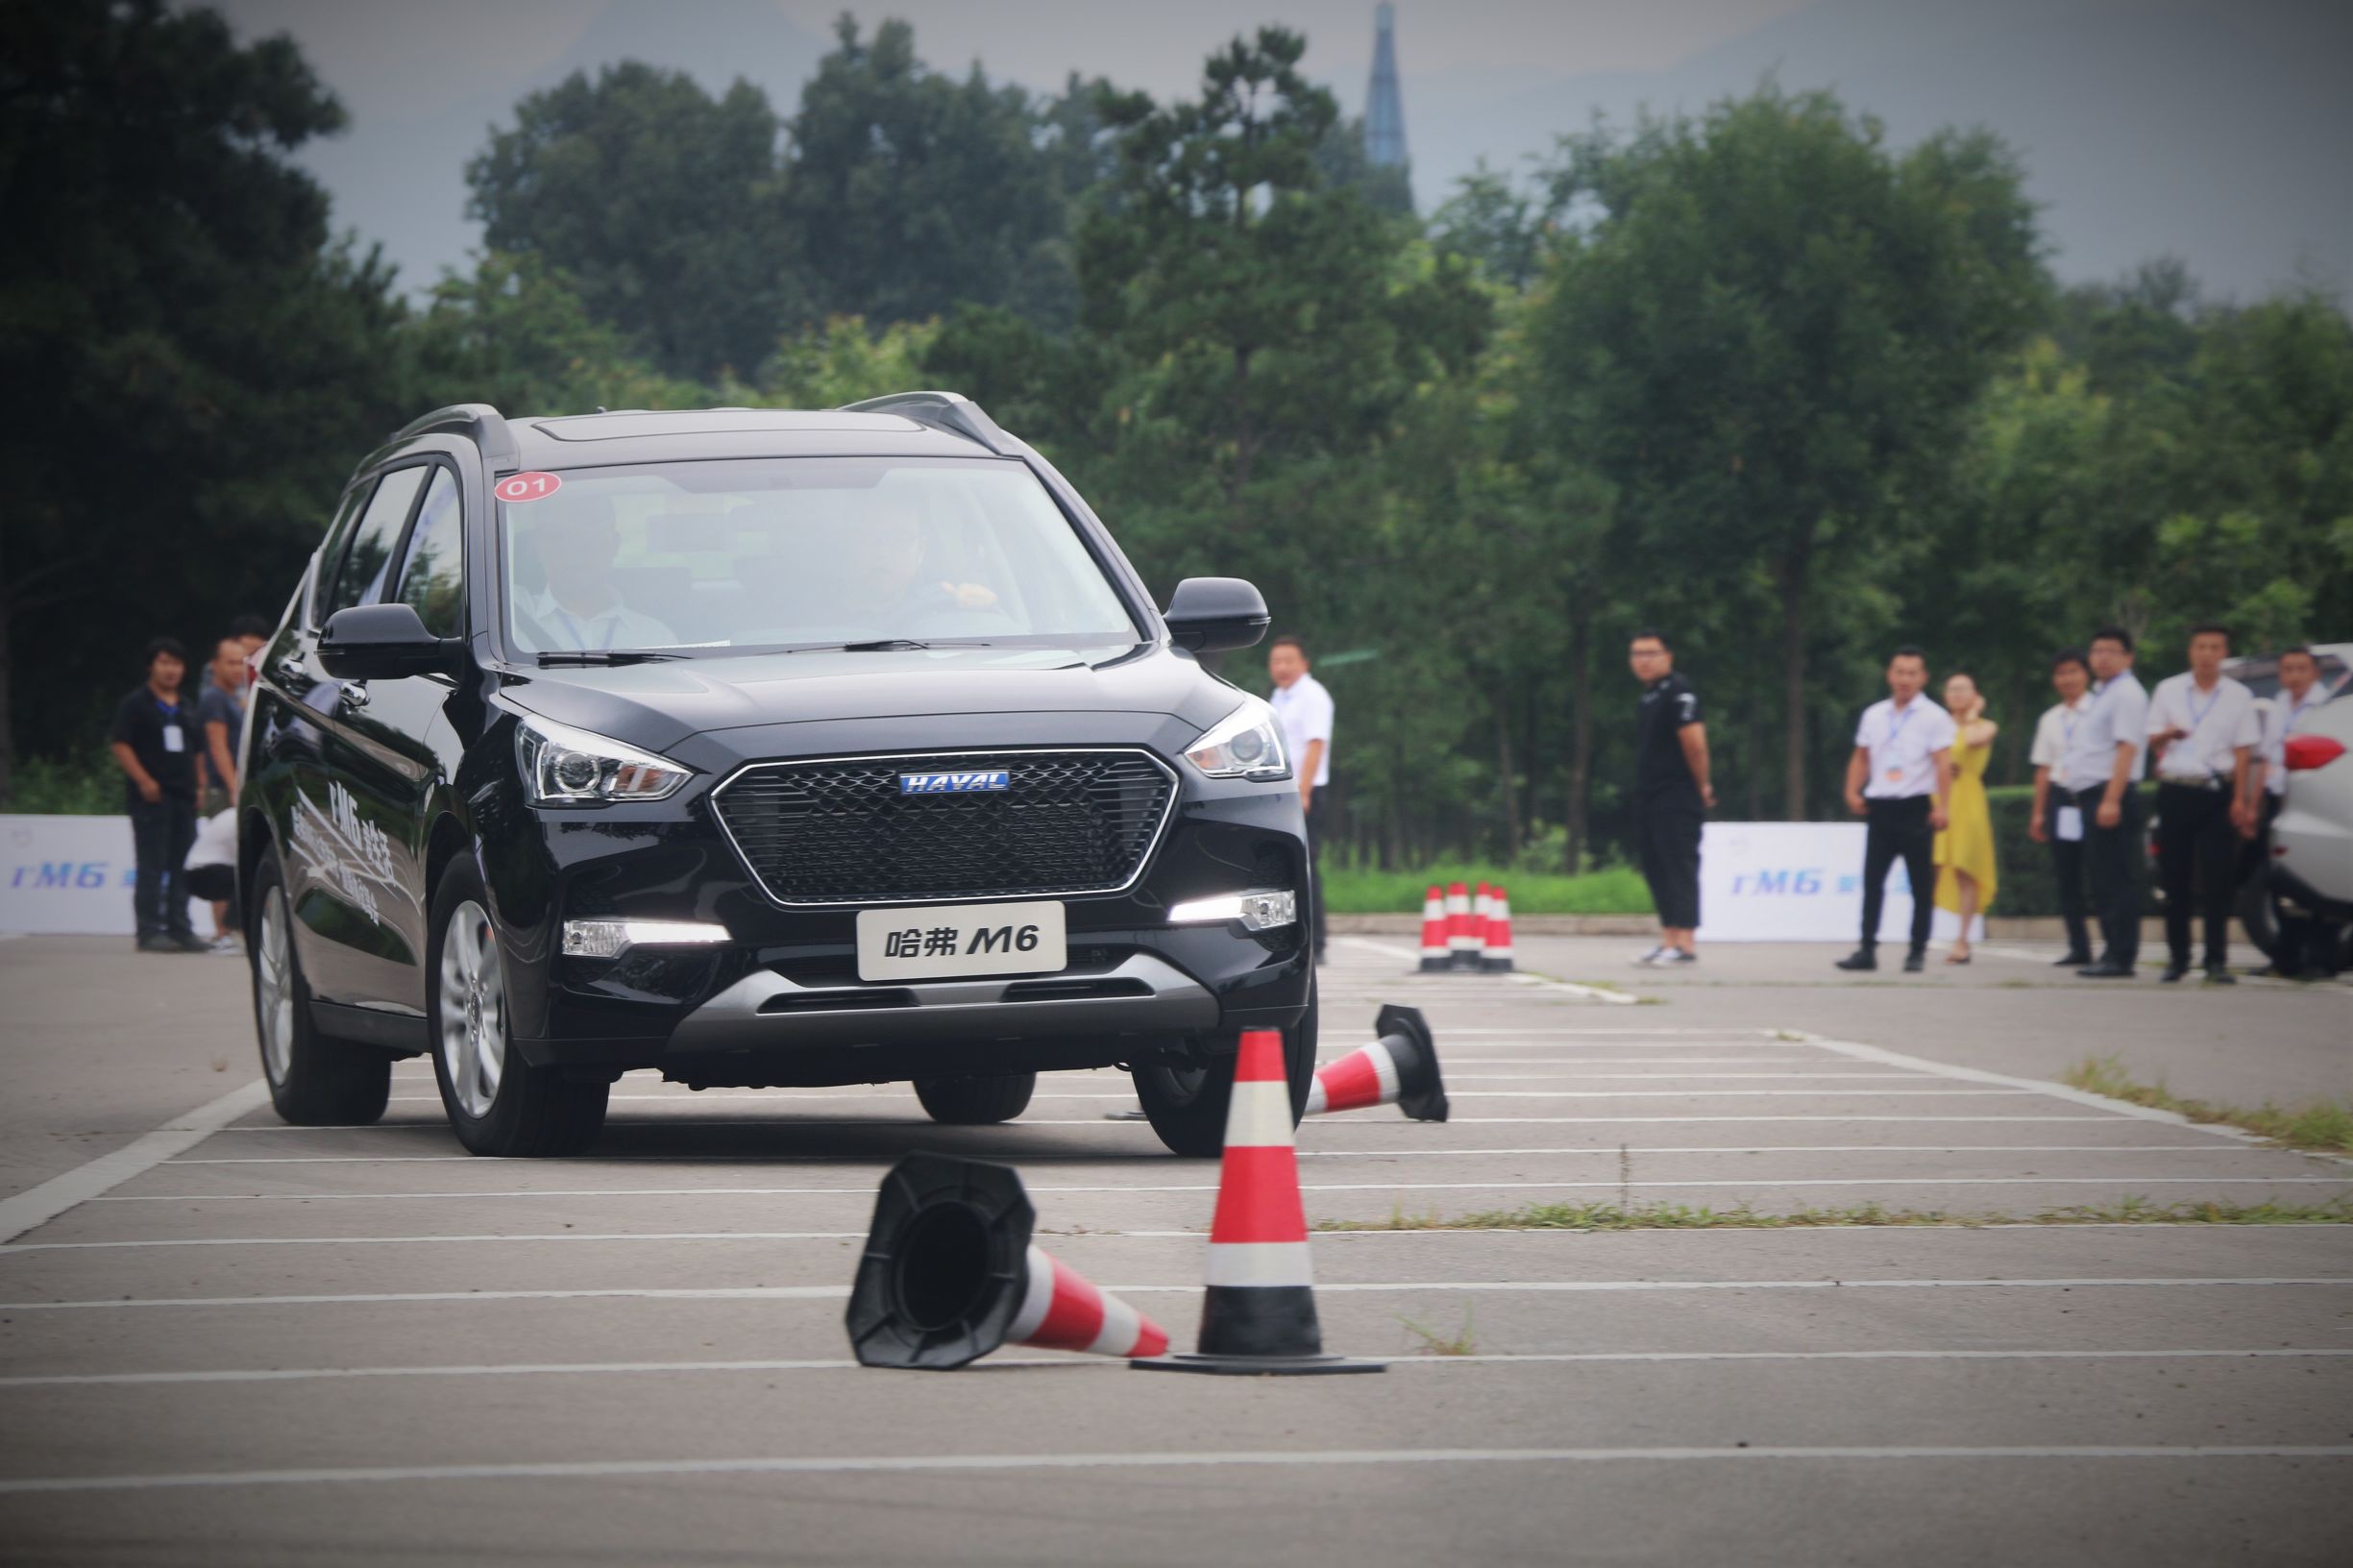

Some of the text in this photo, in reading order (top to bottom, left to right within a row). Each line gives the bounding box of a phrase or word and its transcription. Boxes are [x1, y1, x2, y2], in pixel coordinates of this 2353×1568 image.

[506, 478, 546, 496] 01
[906, 773, 1006, 793] HAVAL
[884, 924, 1040, 958] 哈弗 M6
